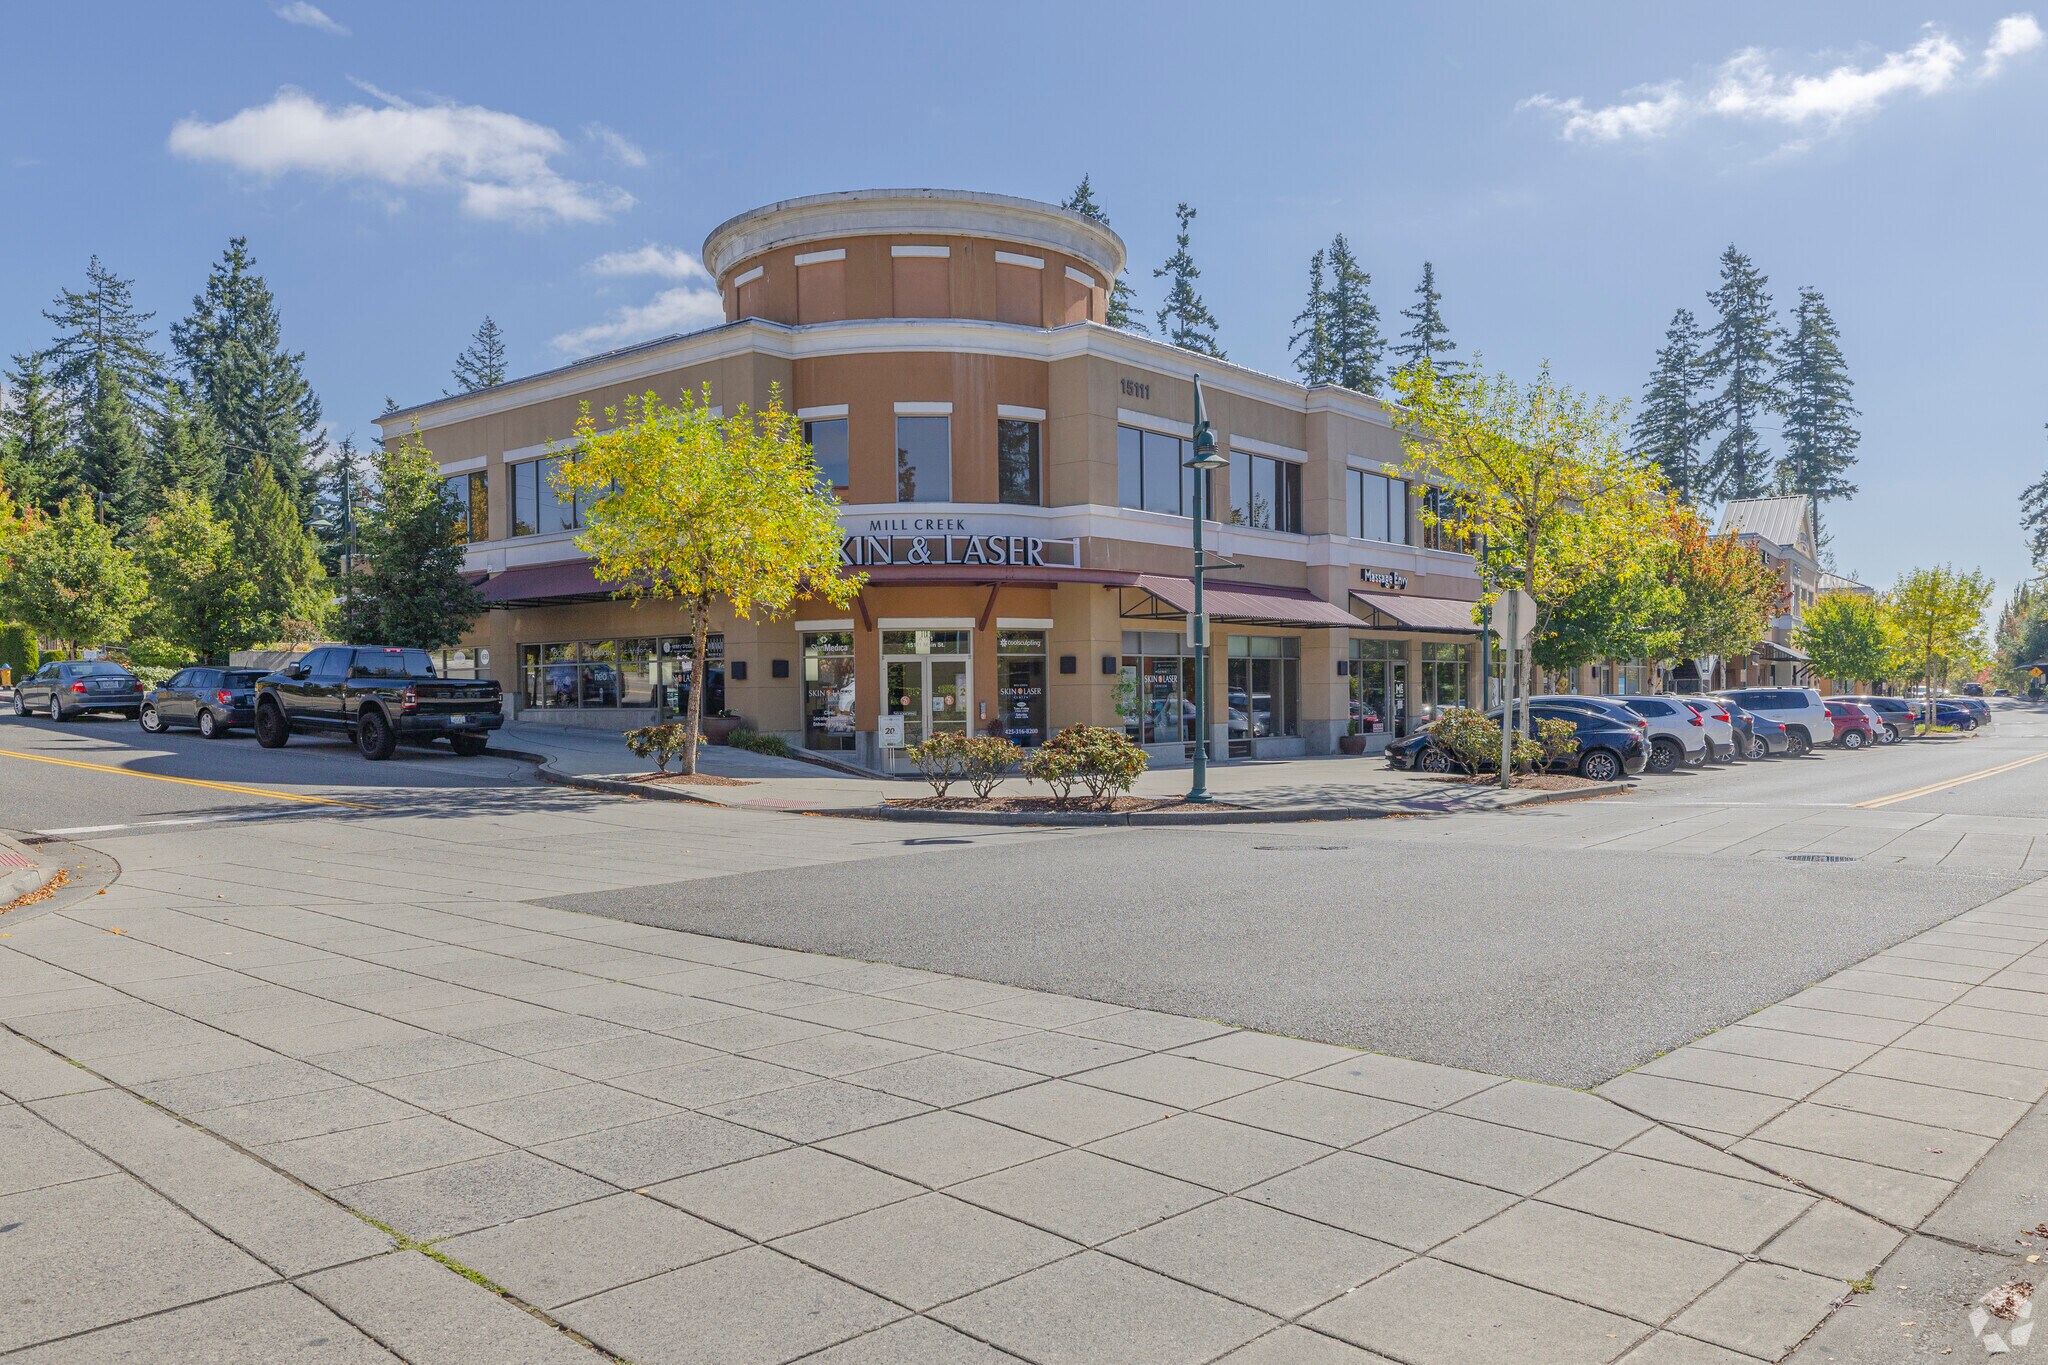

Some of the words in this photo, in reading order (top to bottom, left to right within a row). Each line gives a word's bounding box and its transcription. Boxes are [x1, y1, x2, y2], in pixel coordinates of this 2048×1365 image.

[1121, 378, 1150, 400] 15111
[869, 519, 907, 531] MILL
[914, 518, 966, 531] CREEK
[839, 535, 894, 566] KIN
[907, 535, 932, 565] &
[944, 534, 1045, 567] LASER
[1361, 568, 1393, 588] Massage
[1392, 571, 1409, 590] Envy
[1007, 639, 1041, 648] coolsculpting
[1143, 674, 1158, 683] SKIN
[1163, 674, 1178, 683] LASER
[436, 691, 481, 699] RAM
[808, 689, 826, 697] SKIN
[1000, 687, 1017, 696] SKIN
[1023, 687, 1042, 696] LASER
